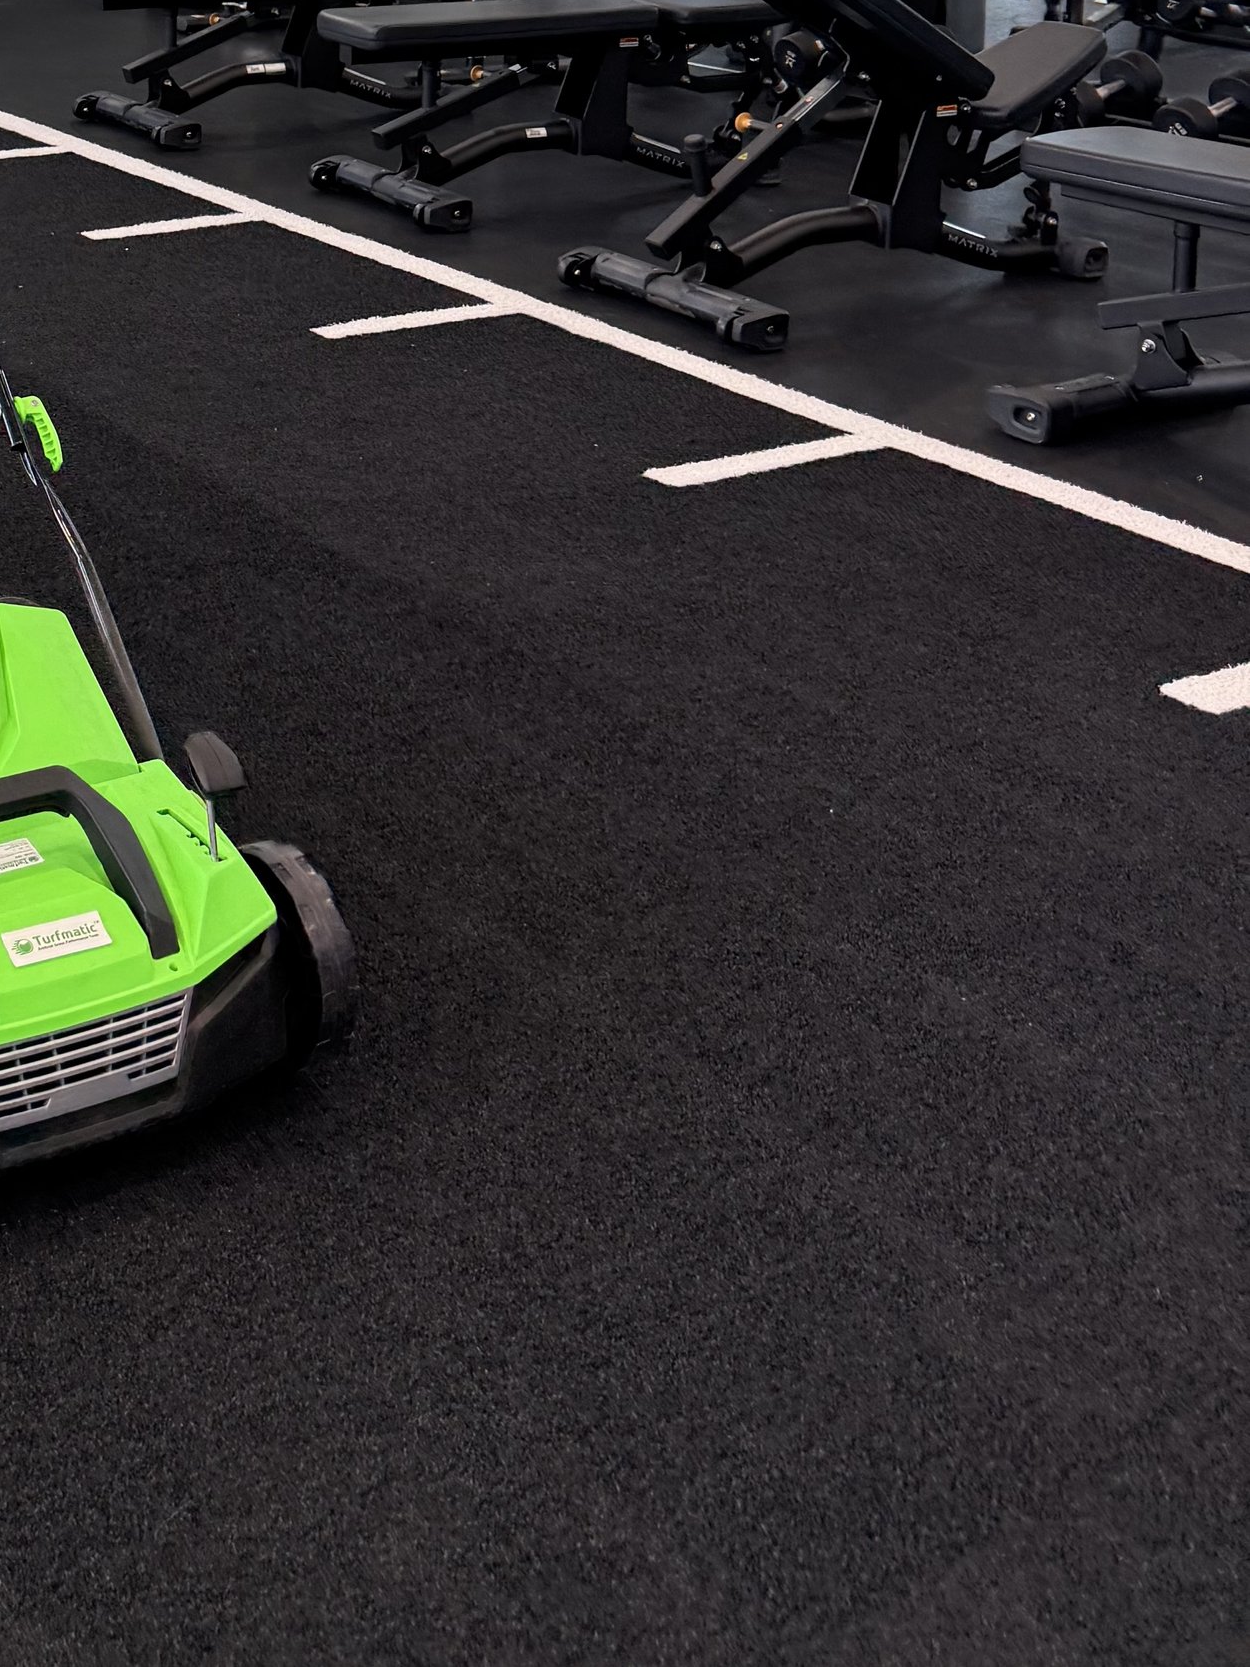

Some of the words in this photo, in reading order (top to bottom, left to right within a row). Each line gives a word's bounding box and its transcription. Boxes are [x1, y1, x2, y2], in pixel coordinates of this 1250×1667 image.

[636, 146, 686, 168] MATRIX
[948, 234, 999, 258] MATRIX
[32, 923, 97, 946] Turfmatic
